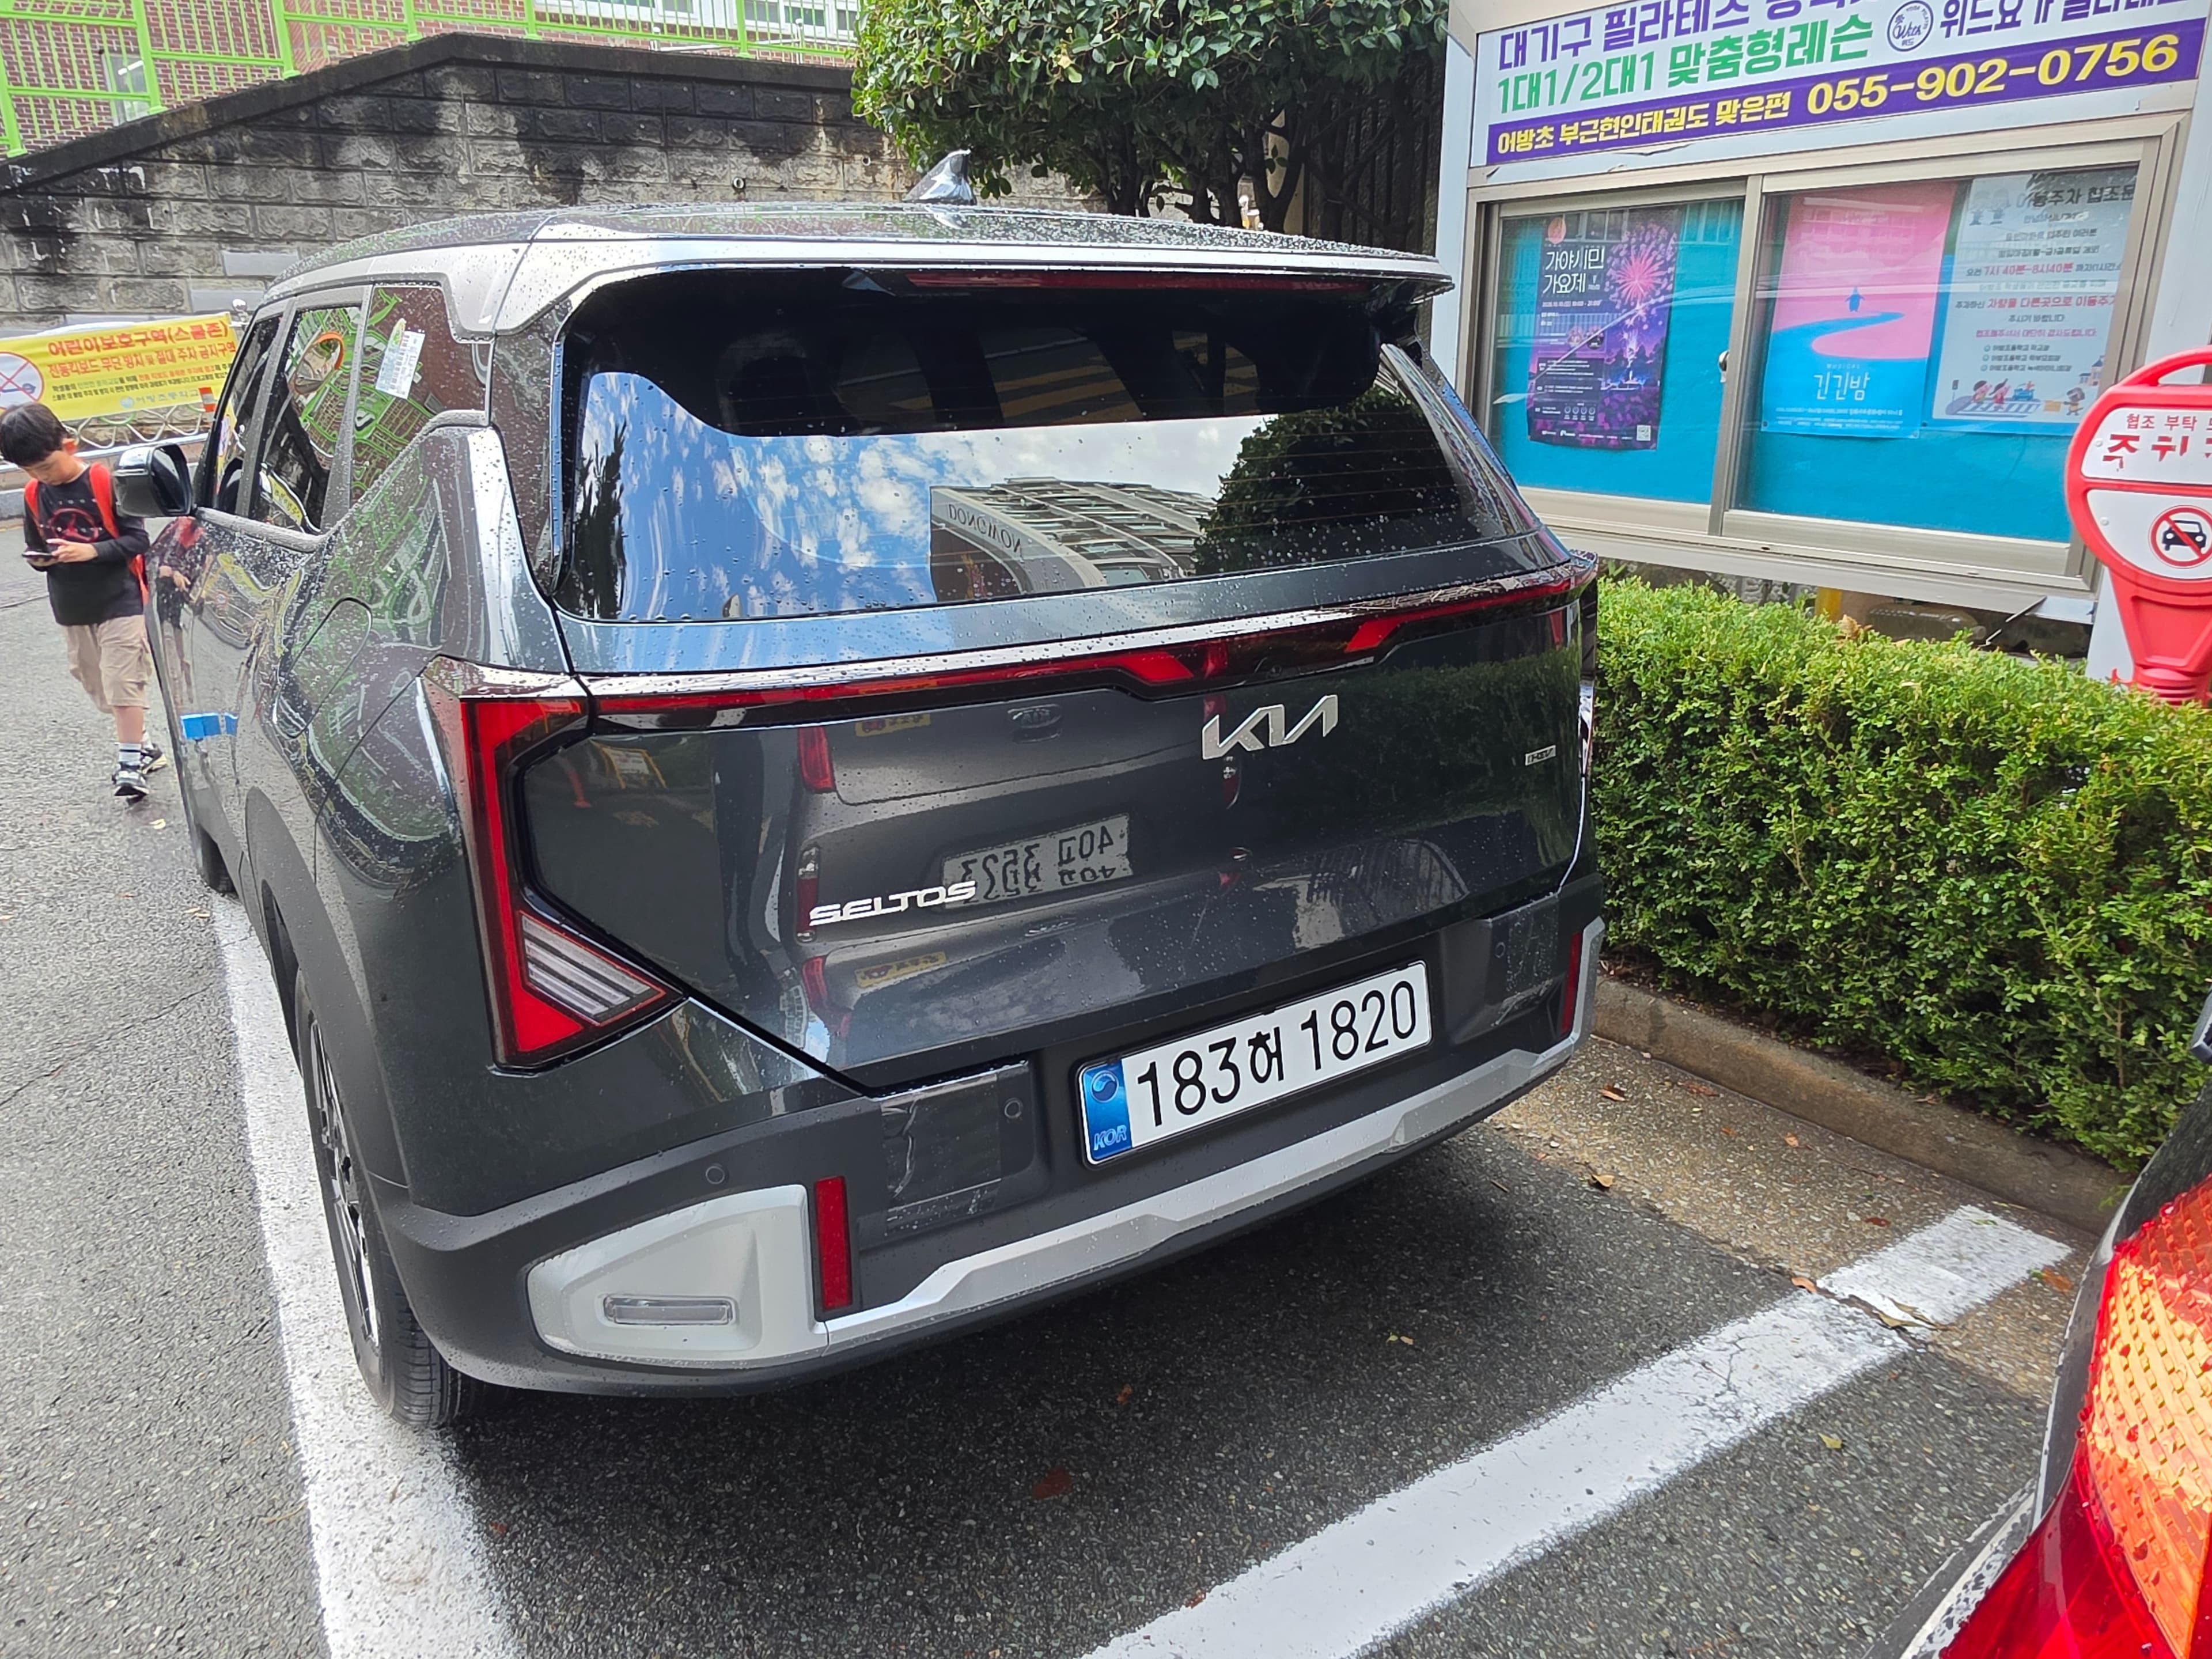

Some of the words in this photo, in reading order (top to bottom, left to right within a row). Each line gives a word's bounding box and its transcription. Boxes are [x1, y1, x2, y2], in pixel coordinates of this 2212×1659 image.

[1499, 16, 1592, 70] 대기구
[1603, 0, 1749, 52] 필라테스
[1498, 51, 1654, 113] 1대1/2대1
[1668, 14, 1873, 88] 맞춤형레슨
[1498, 126, 1554, 154] 어방초
[1715, 91, 1791, 125] 맞은편
[1806, 33, 2180, 115] 055-902-0756
[1545, 247, 1605, 271] 가야시민
[1542, 273, 1586, 294] 가요제
[48, 320, 229, 357] 어린이보호구역(스쿨존)
[47, 358, 101, 379] 전동킥보드
[101, 354, 123, 372] 무단
[178, 344, 198, 361] 주차
[1813, 372, 1870, 401] 긴긴밤
[2126, 413, 2155, 429] 협조
[2164, 415, 2198, 431] 부탁
[1202, 694, 1338, 760] KIA
[809, 880, 977, 926] SELTOS
[1137, 1027, 1285, 1127] 183허
[1301, 980, 1416, 1070] 1820
[1093, 1124, 1127, 1152] KOR
